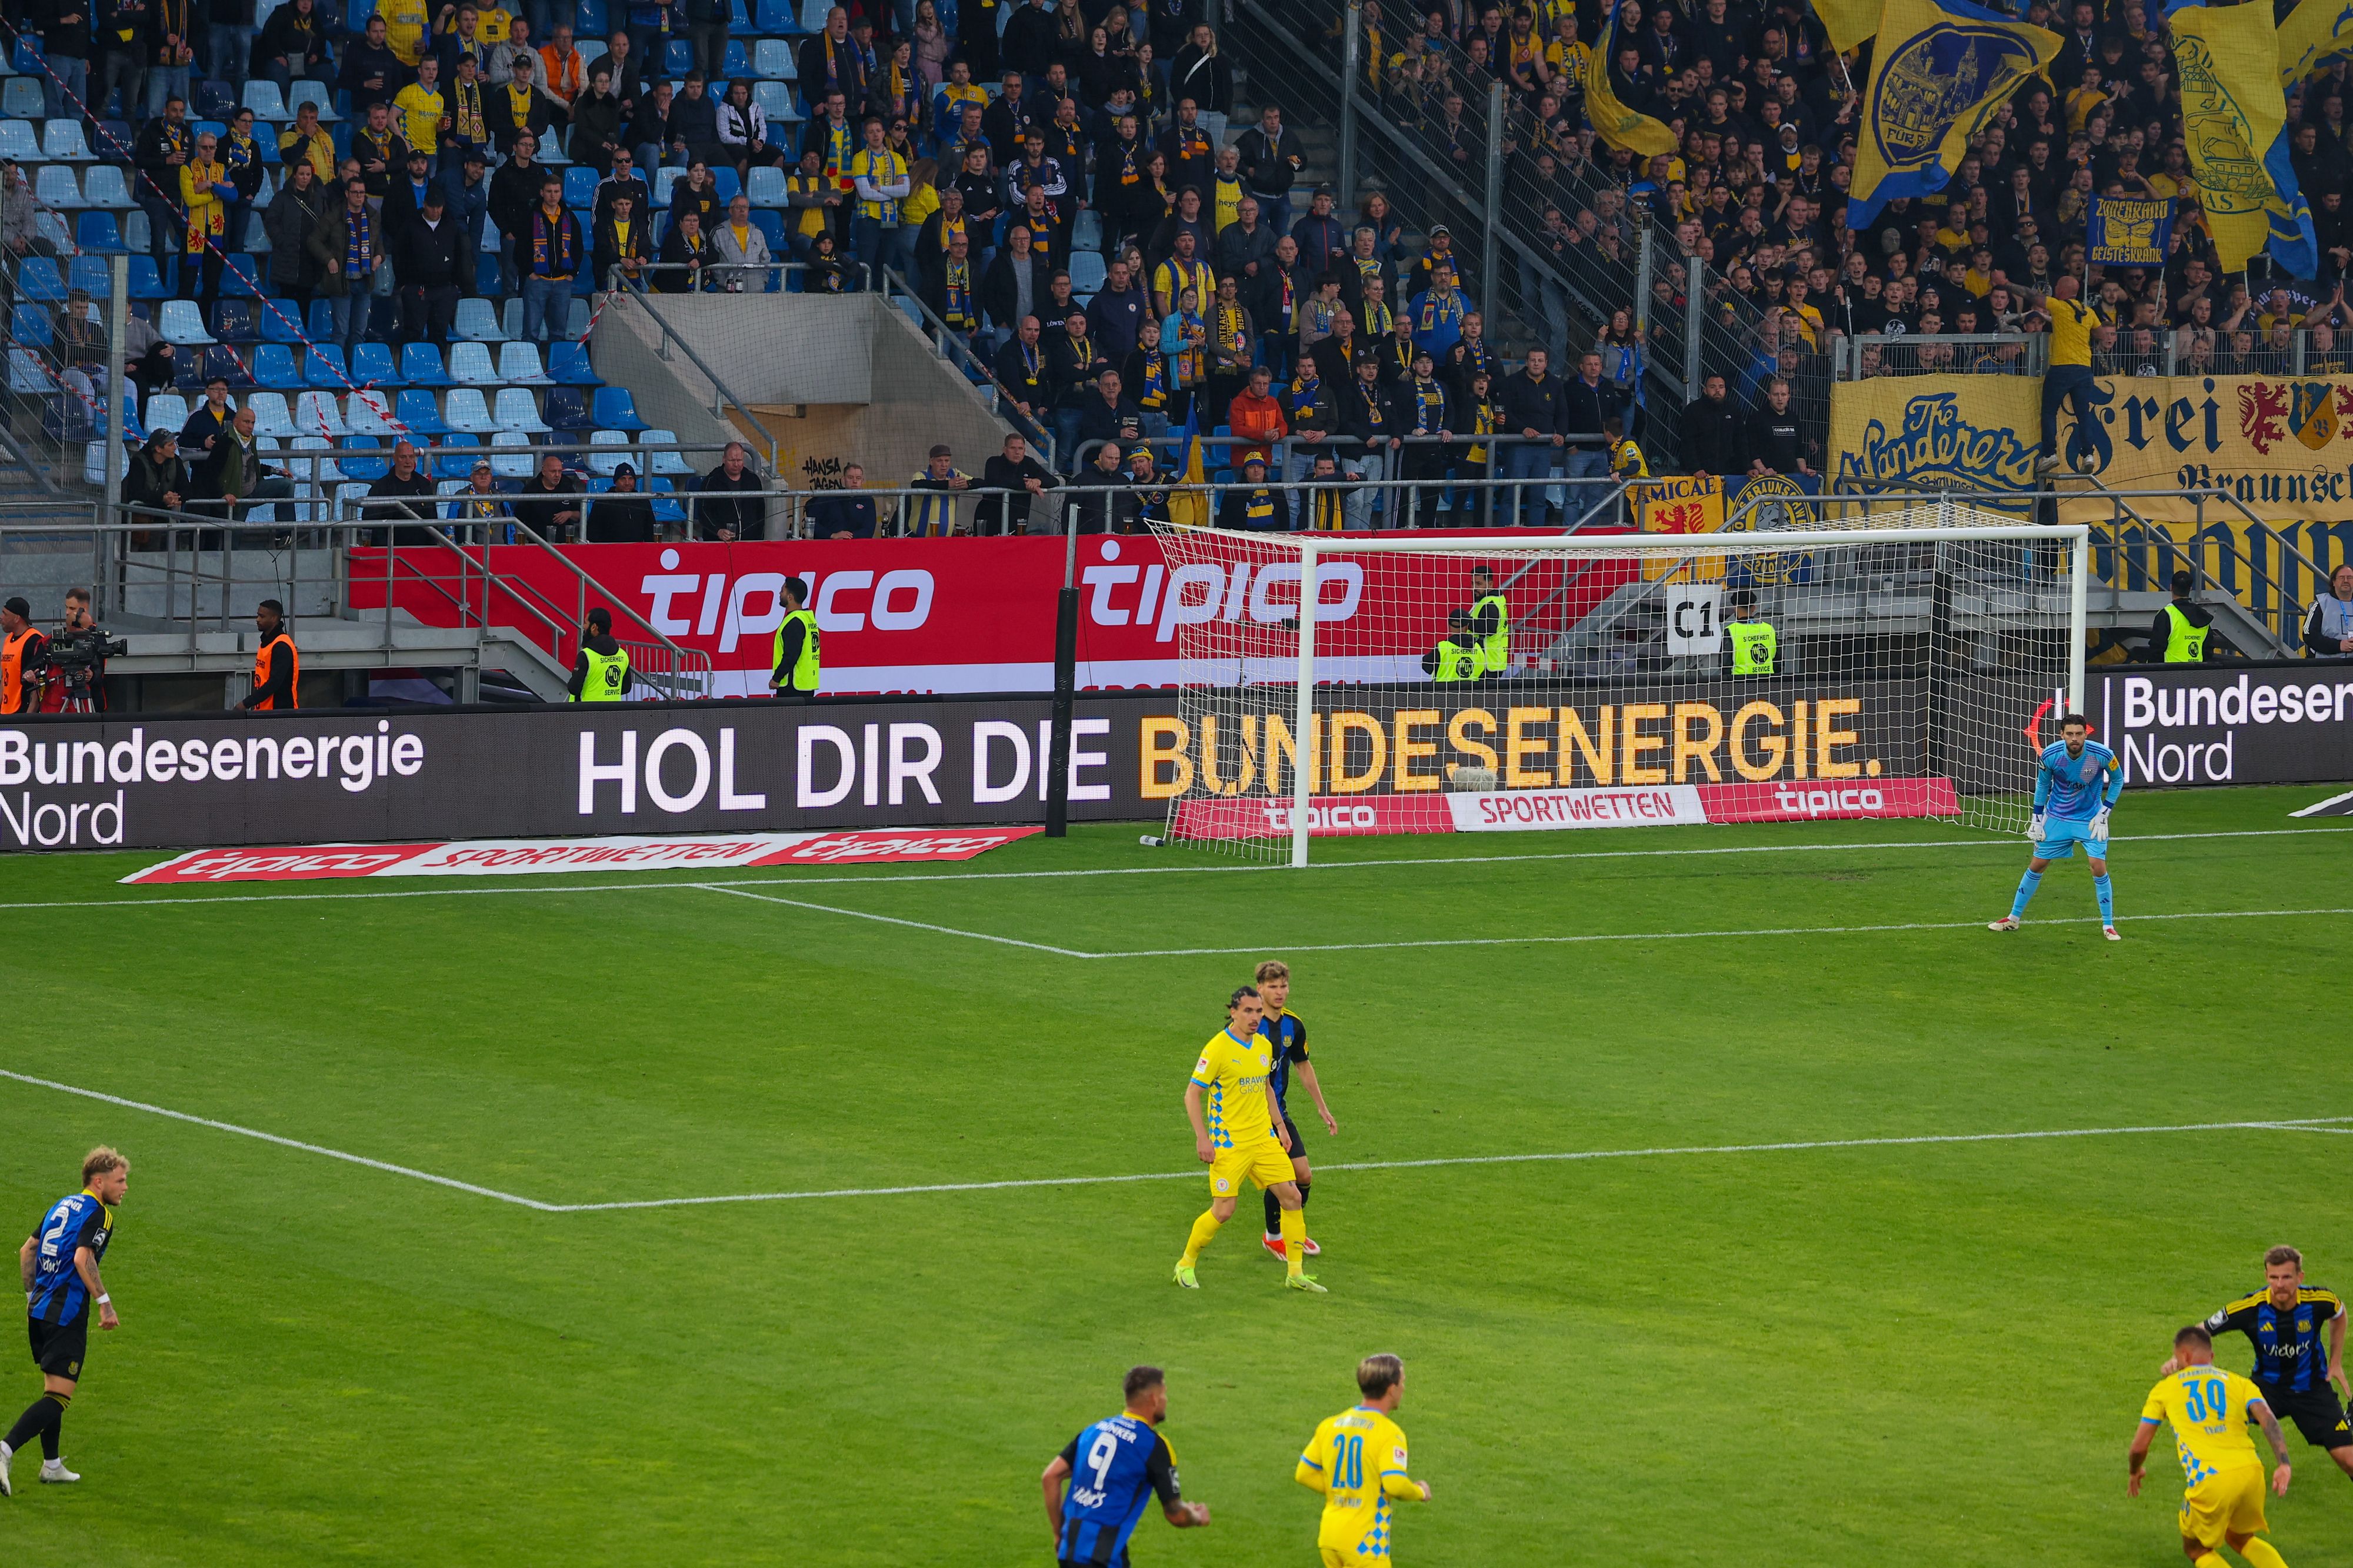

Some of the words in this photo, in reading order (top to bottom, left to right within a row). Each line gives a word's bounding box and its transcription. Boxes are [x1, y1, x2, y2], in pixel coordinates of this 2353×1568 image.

[1887, 127, 1914, 143] FÜR
[2092, 246, 2164, 263] GEISTESKRANK
[1904, 392, 1958, 432] The
[2061, 378, 2224, 476] Frei
[802, 456, 841, 477] HANSA
[2177, 463, 2353, 505] Braunsc
[641, 548, 935, 653] tipico
[1081, 539, 1364, 643] tipico
[1674, 601, 1714, 638] C1
[1742, 634, 1769, 642] SICHERHEIT
[600, 656, 624, 664] SICHERHEIT
[0, 720, 424, 792] Bundesenergie
[578, 727, 766, 814] HOL
[796, 722, 942, 808] DIR
[972, 718, 1111, 803] DIE
[1139, 698, 1882, 799] BUNDESENERGIE.
[2124, 730, 2233, 783] Nord
[0, 789, 124, 846] Nord
[1479, 792, 1676, 823] SPORTWETTEN
[1774, 782, 1884, 817] tipico
[178, 851, 402, 880] tipico
[419, 842, 772, 868] SPORTWETTEN
[792, 835, 1008, 861] tipico
[41, 1206, 69, 1257] 2
[2182, 1379, 2227, 1424] 39
[1087, 1432, 1118, 1491] 9
[1331, 1434, 1364, 1490] 20
